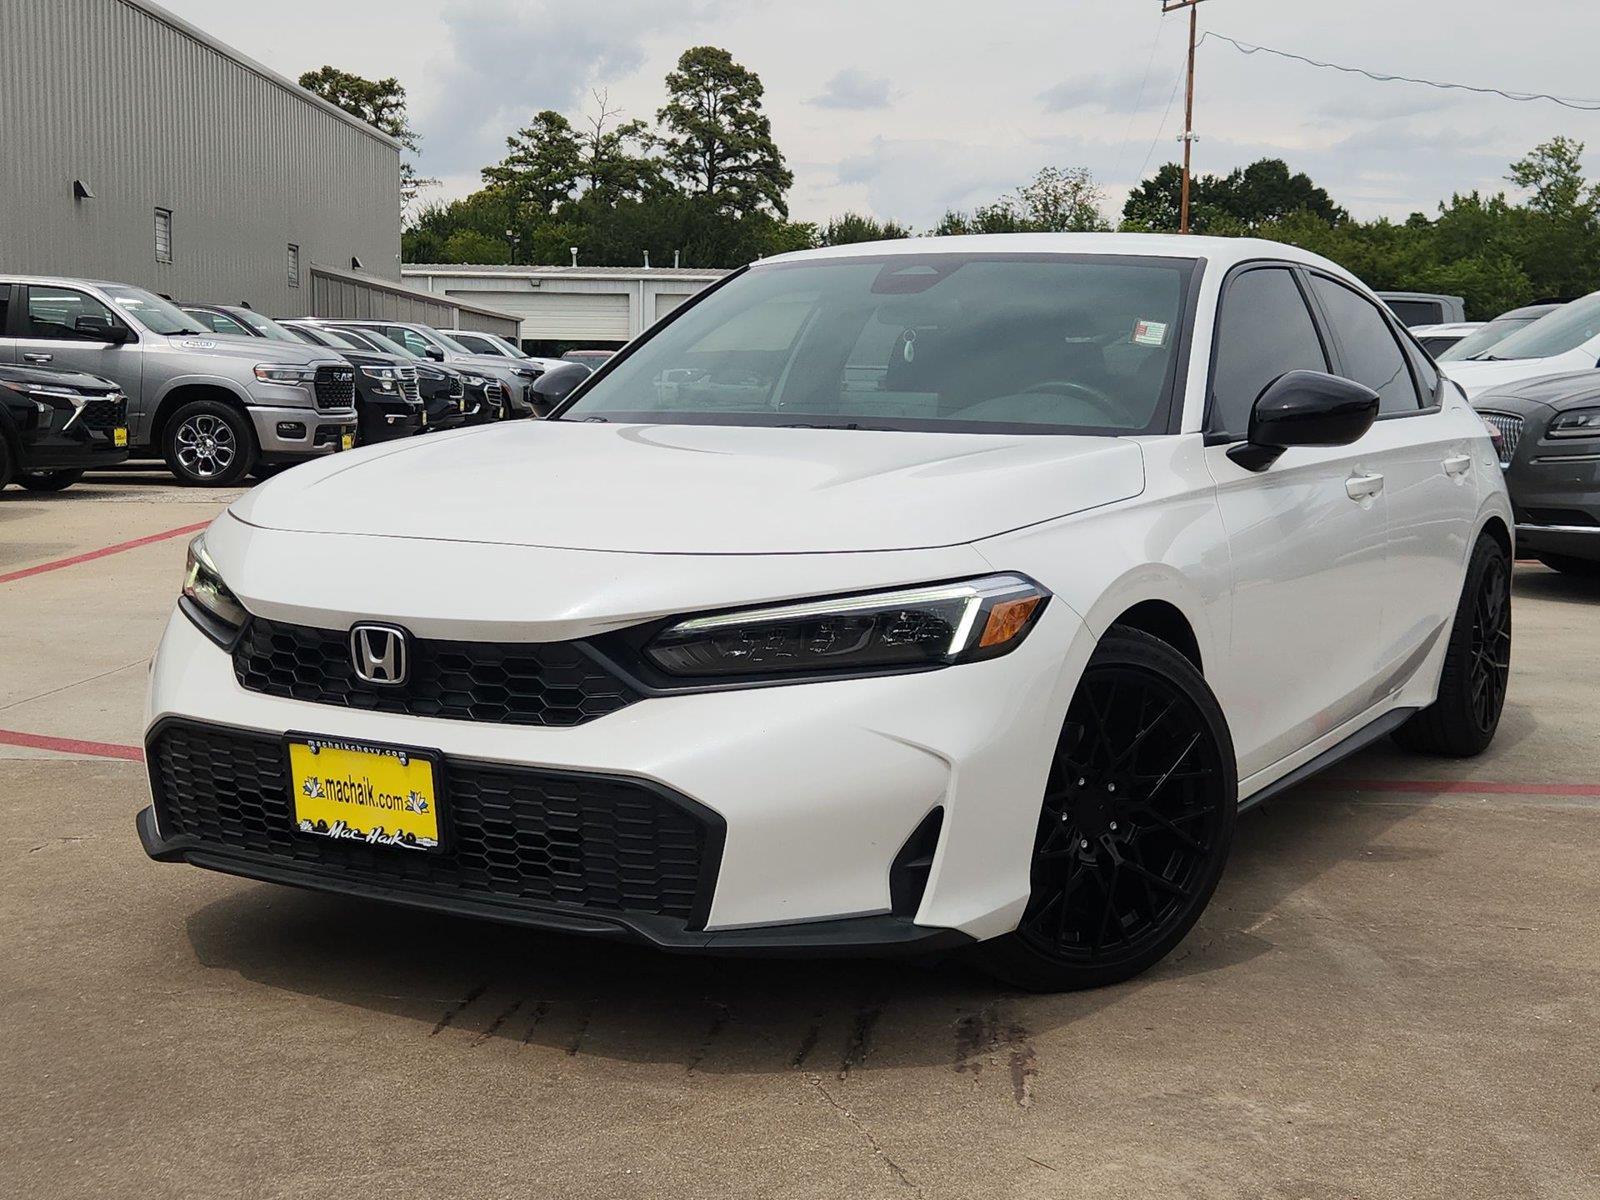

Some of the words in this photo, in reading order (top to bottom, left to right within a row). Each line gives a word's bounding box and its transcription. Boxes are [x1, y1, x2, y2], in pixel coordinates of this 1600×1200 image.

[307, 740, 406, 757] machaikchevy.com
[325, 775, 403, 811] machaik.com
[327, 821, 363, 841] Mac
[365, 827, 405, 846] Haik
